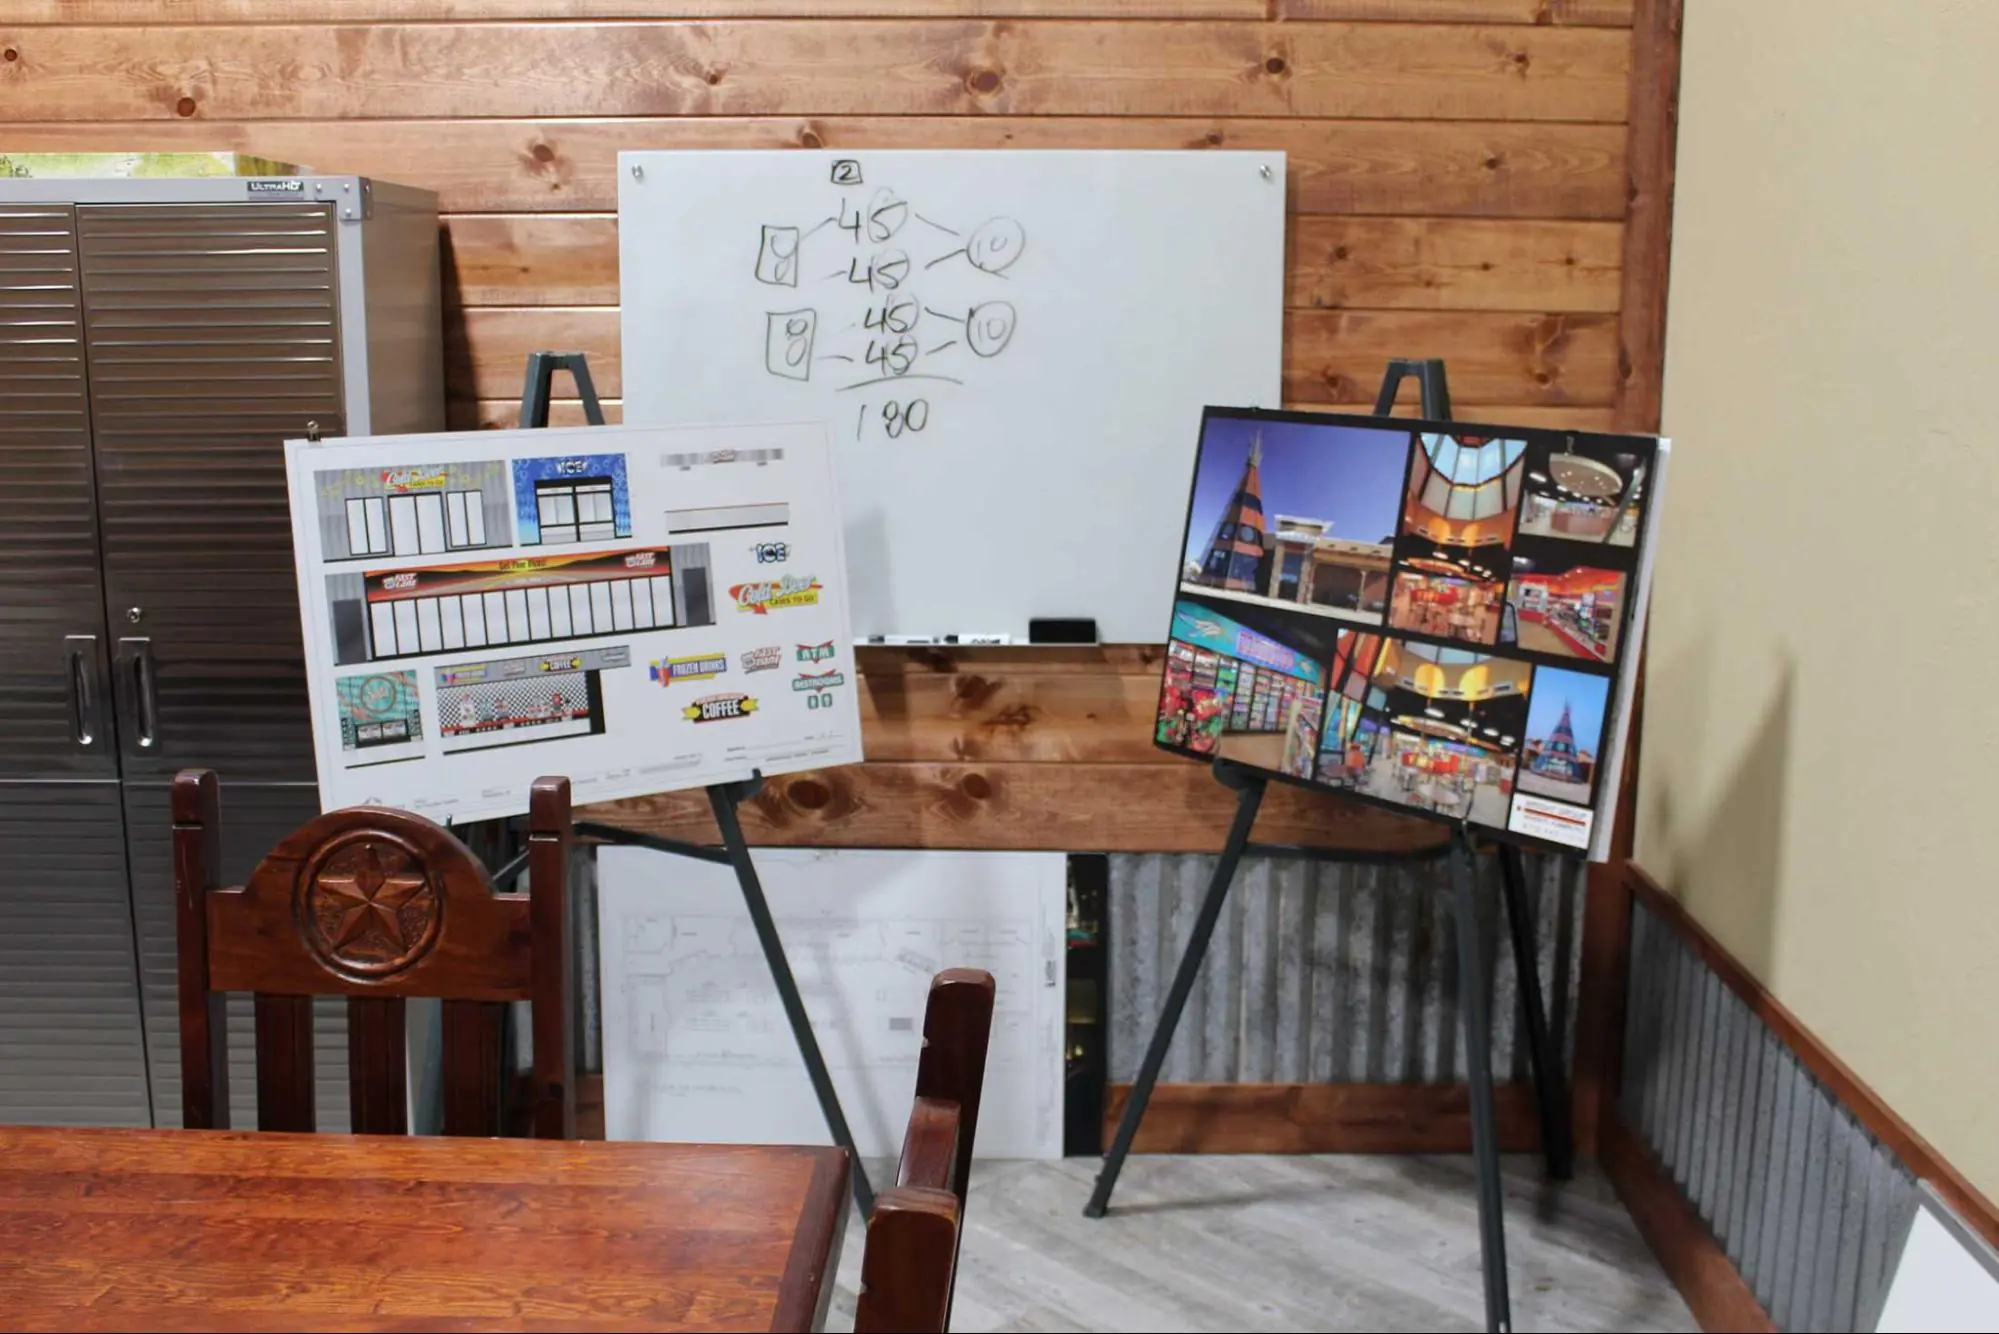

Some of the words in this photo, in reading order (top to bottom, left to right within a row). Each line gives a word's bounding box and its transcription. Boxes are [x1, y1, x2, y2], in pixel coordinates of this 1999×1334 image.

[838, 197, 908, 244] 45
[848, 256, 909, 293] 45
[863, 301, 914, 333] 45
[864, 340, 910, 376] 45
[856, 398, 929, 442] 180
[756, 542, 787, 563] ICE
[702, 699, 740, 719] COFFEE
